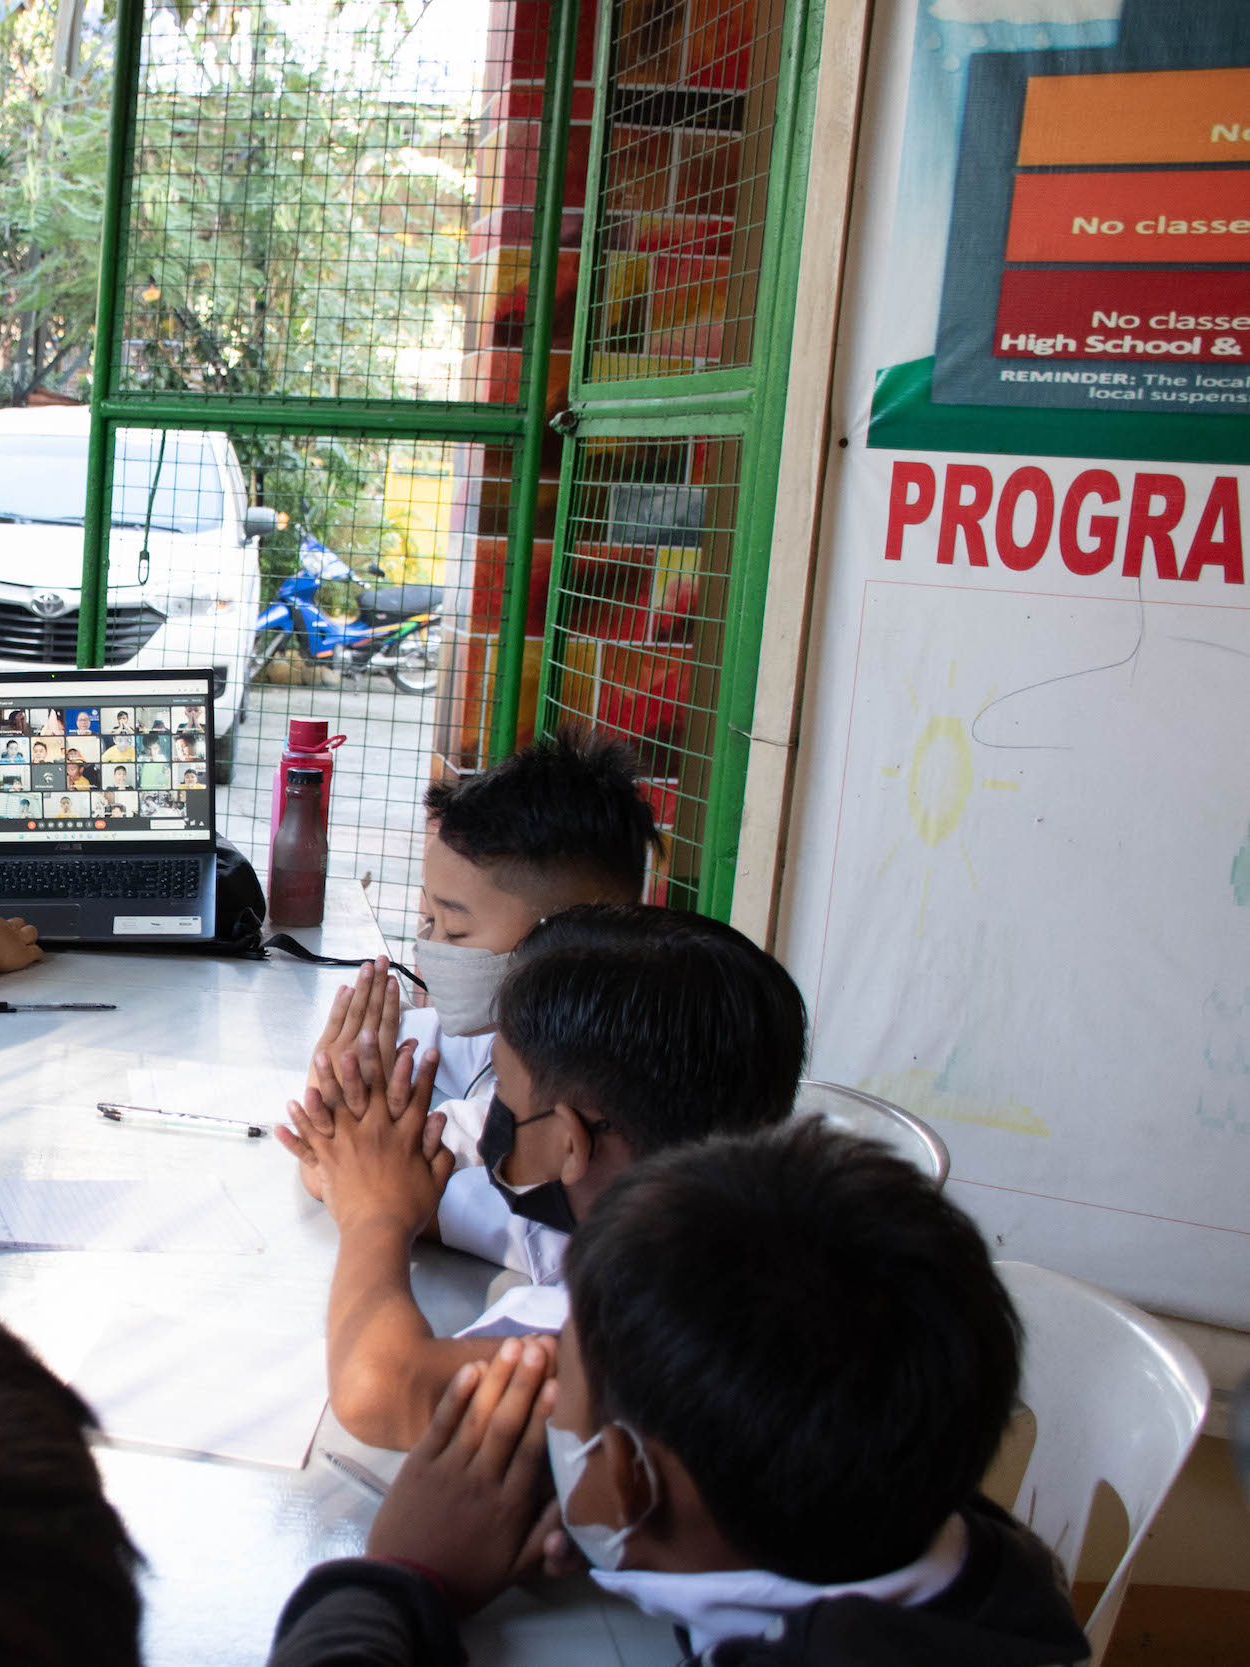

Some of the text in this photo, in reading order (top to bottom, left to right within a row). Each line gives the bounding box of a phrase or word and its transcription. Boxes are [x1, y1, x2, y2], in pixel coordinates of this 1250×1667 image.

[1072, 215, 1250, 235] No classe
[1092, 311, 1250, 331] No classe
[1000, 333, 1243, 356] High School &
[1000, 370, 1250, 389] REMINDER: The local
[1088, 386, 1250, 405] local suspens
[884, 460, 1246, 585] PROGRA
